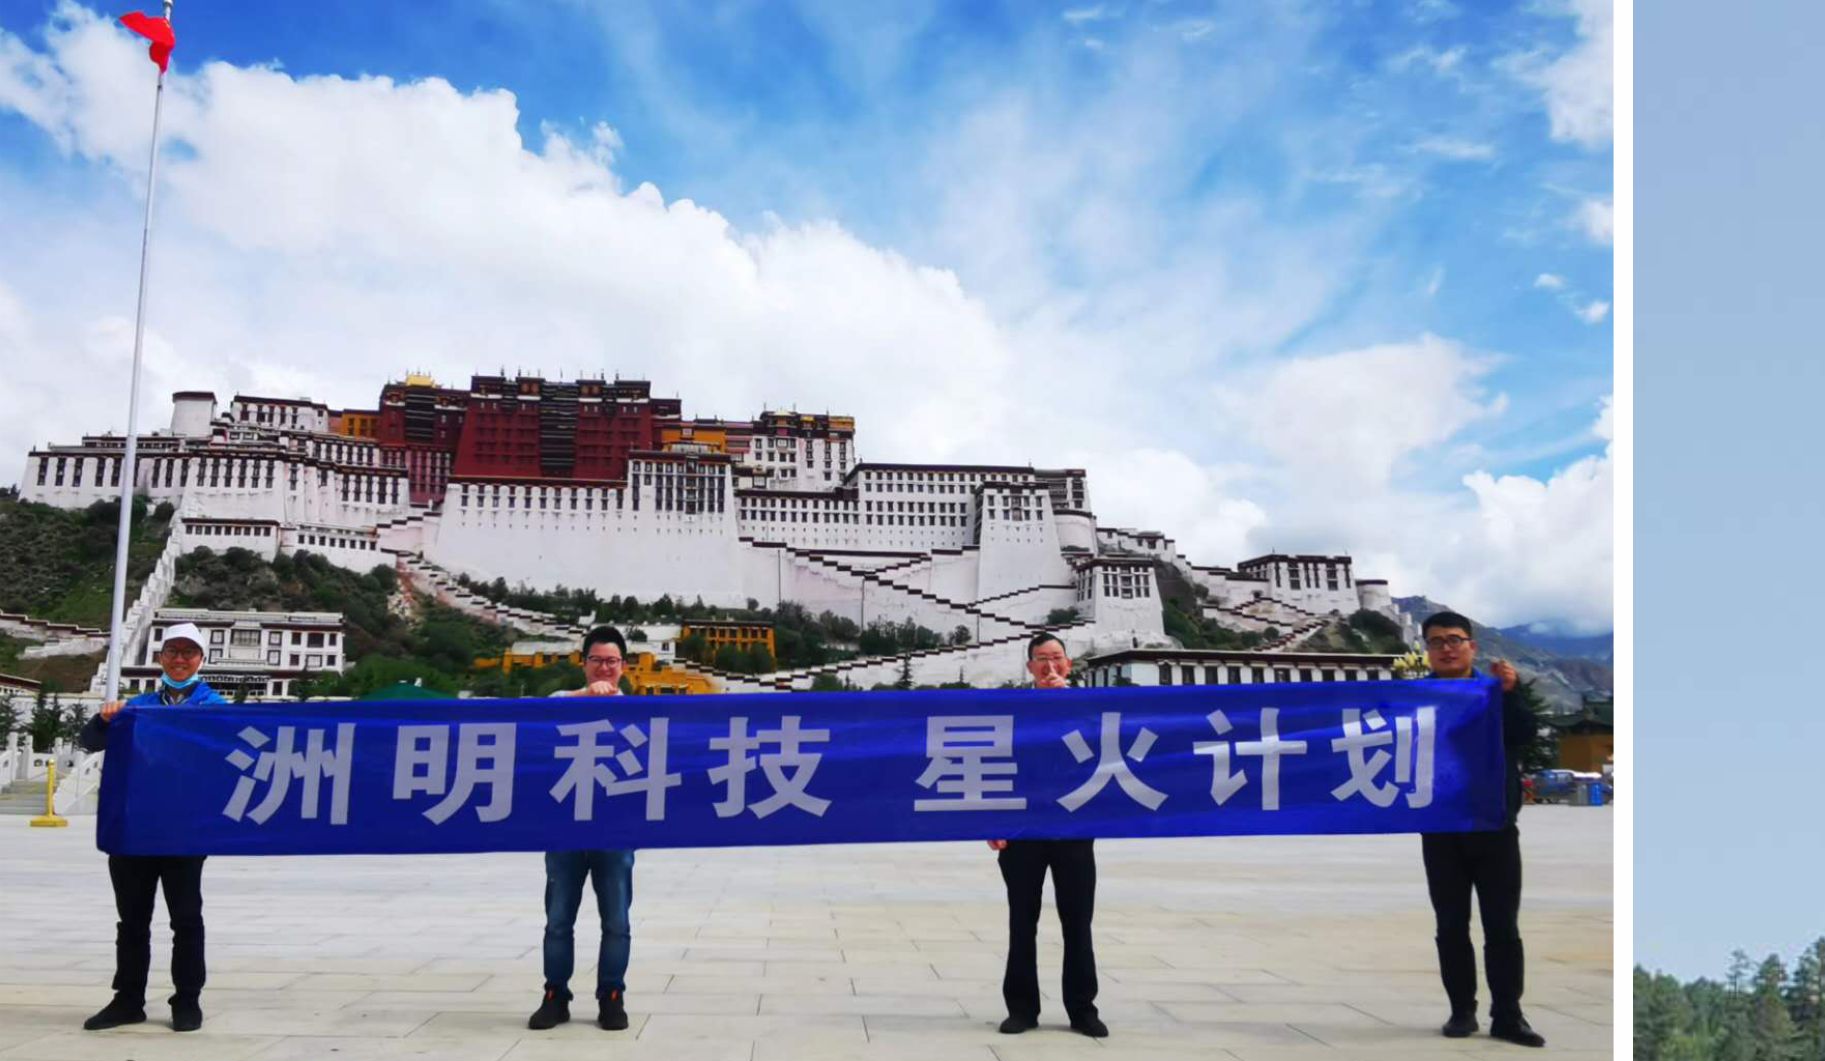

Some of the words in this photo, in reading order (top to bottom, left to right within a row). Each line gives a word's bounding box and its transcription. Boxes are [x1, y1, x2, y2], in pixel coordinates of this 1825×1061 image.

[223, 715, 833, 826] 洲明科技
[914, 705, 1438, 813] 星火计划
